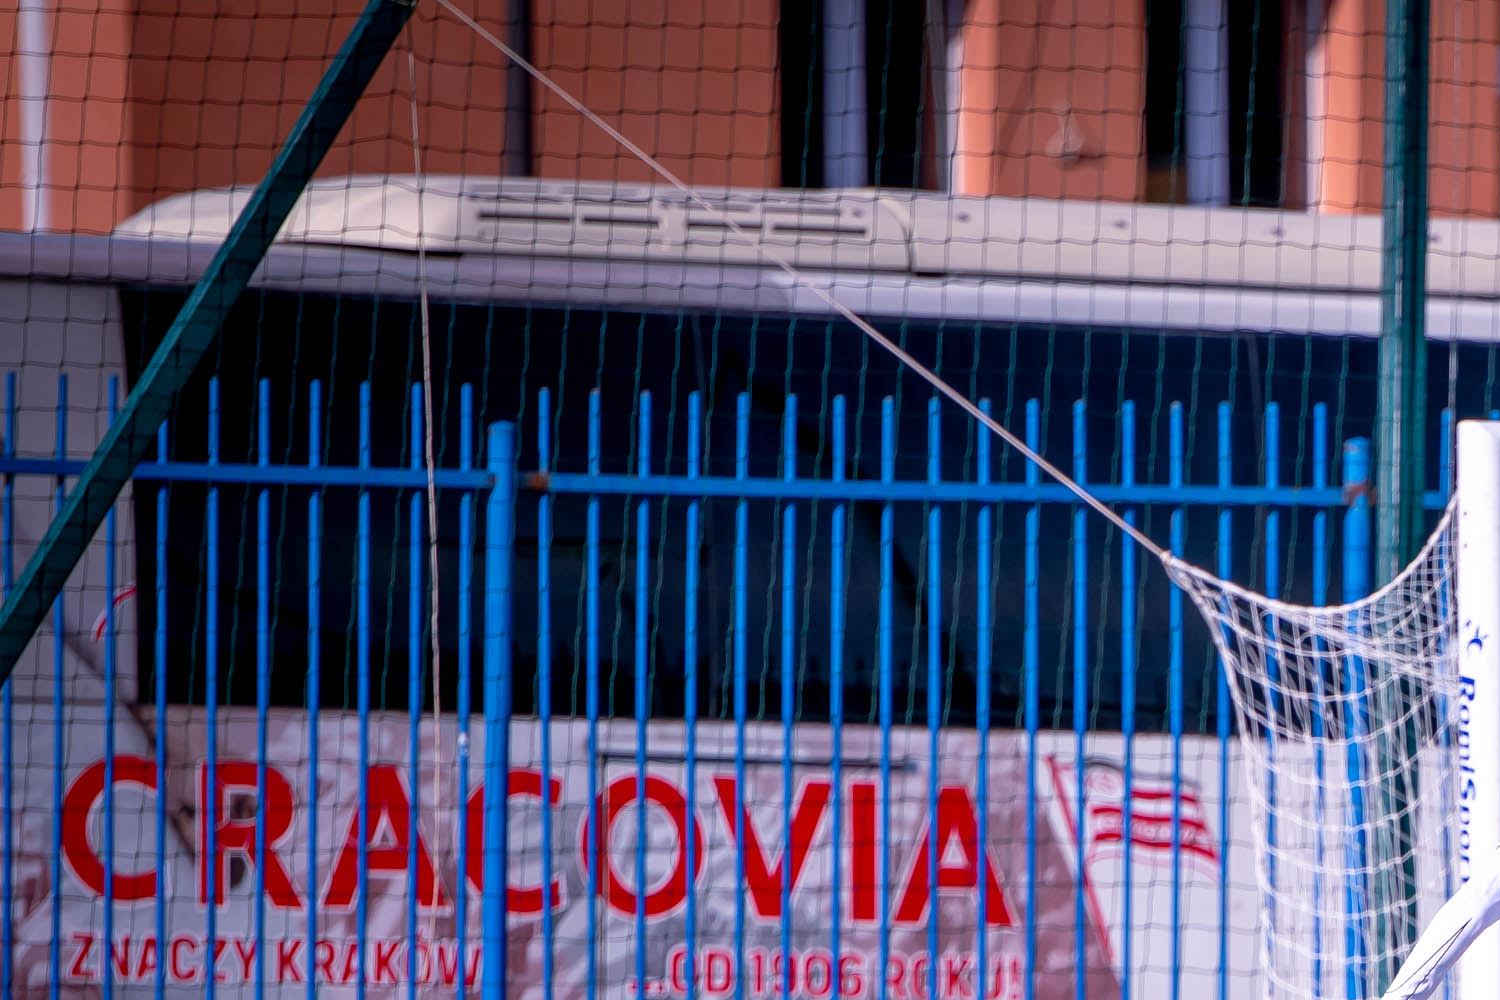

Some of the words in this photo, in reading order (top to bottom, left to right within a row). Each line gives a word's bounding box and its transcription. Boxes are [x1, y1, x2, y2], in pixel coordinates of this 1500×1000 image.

[62, 755, 1012, 928] CRACOVIA
[71, 932, 257, 981] ZNACZY
[277, 933, 481, 986] KRAKÓW
[747, 951, 863, 998] 1906
